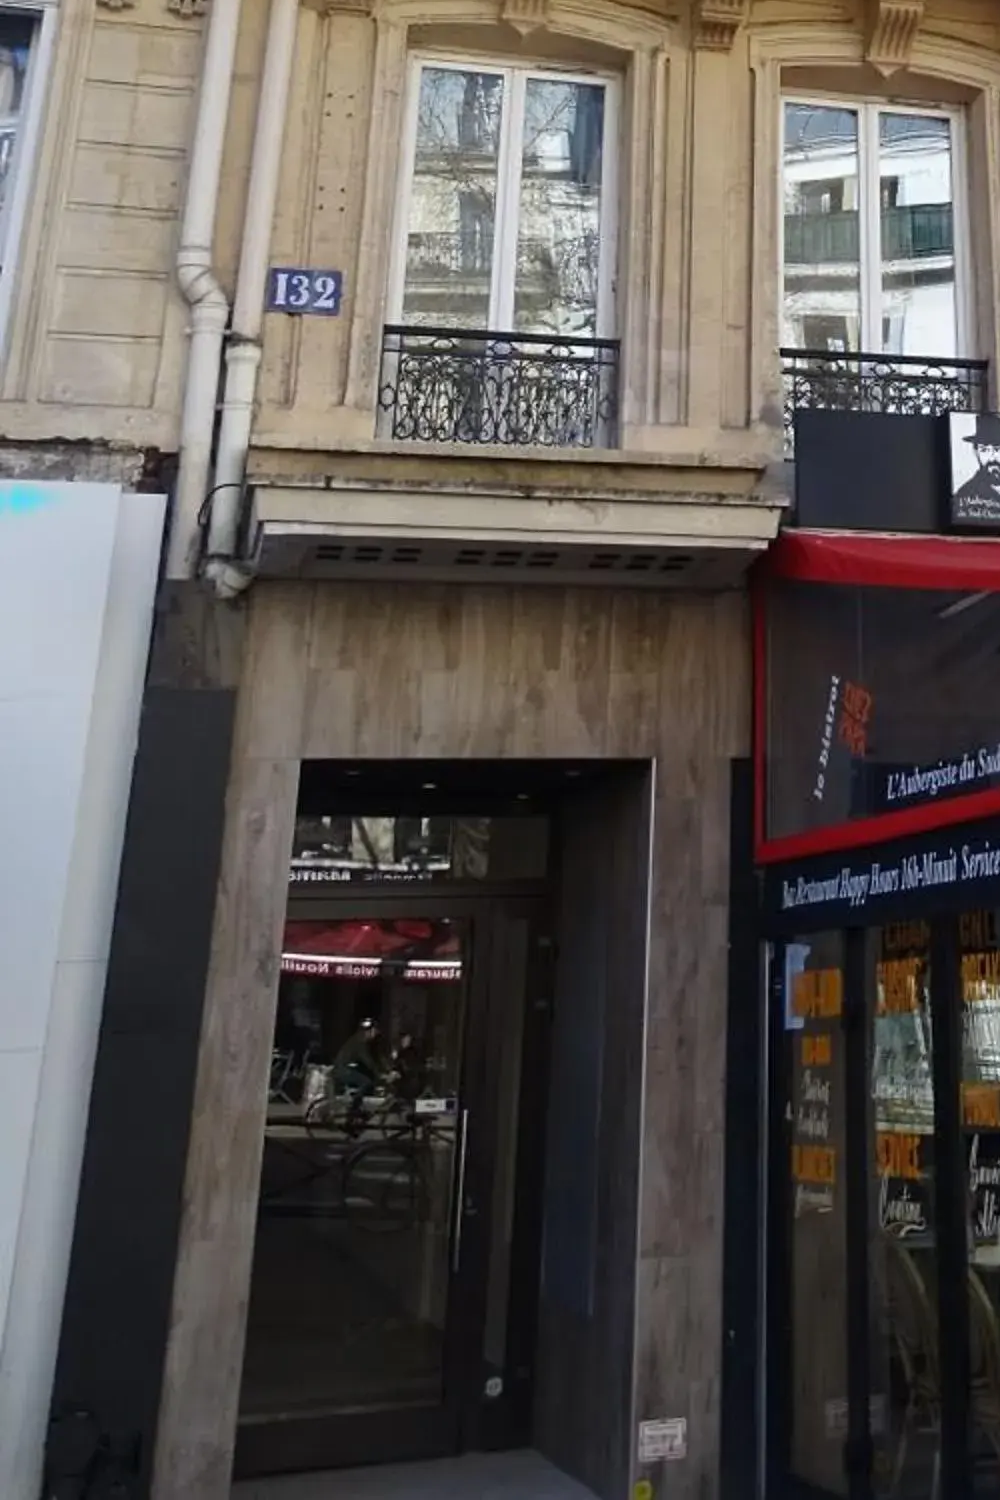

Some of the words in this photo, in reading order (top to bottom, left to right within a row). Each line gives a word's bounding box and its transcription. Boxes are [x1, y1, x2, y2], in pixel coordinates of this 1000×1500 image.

[274, 273, 336, 309] 132
[887, 761, 958, 800] L'Aubergiste
[959, 753, 975, 781] du
[961, 843, 1000, 880] Service
